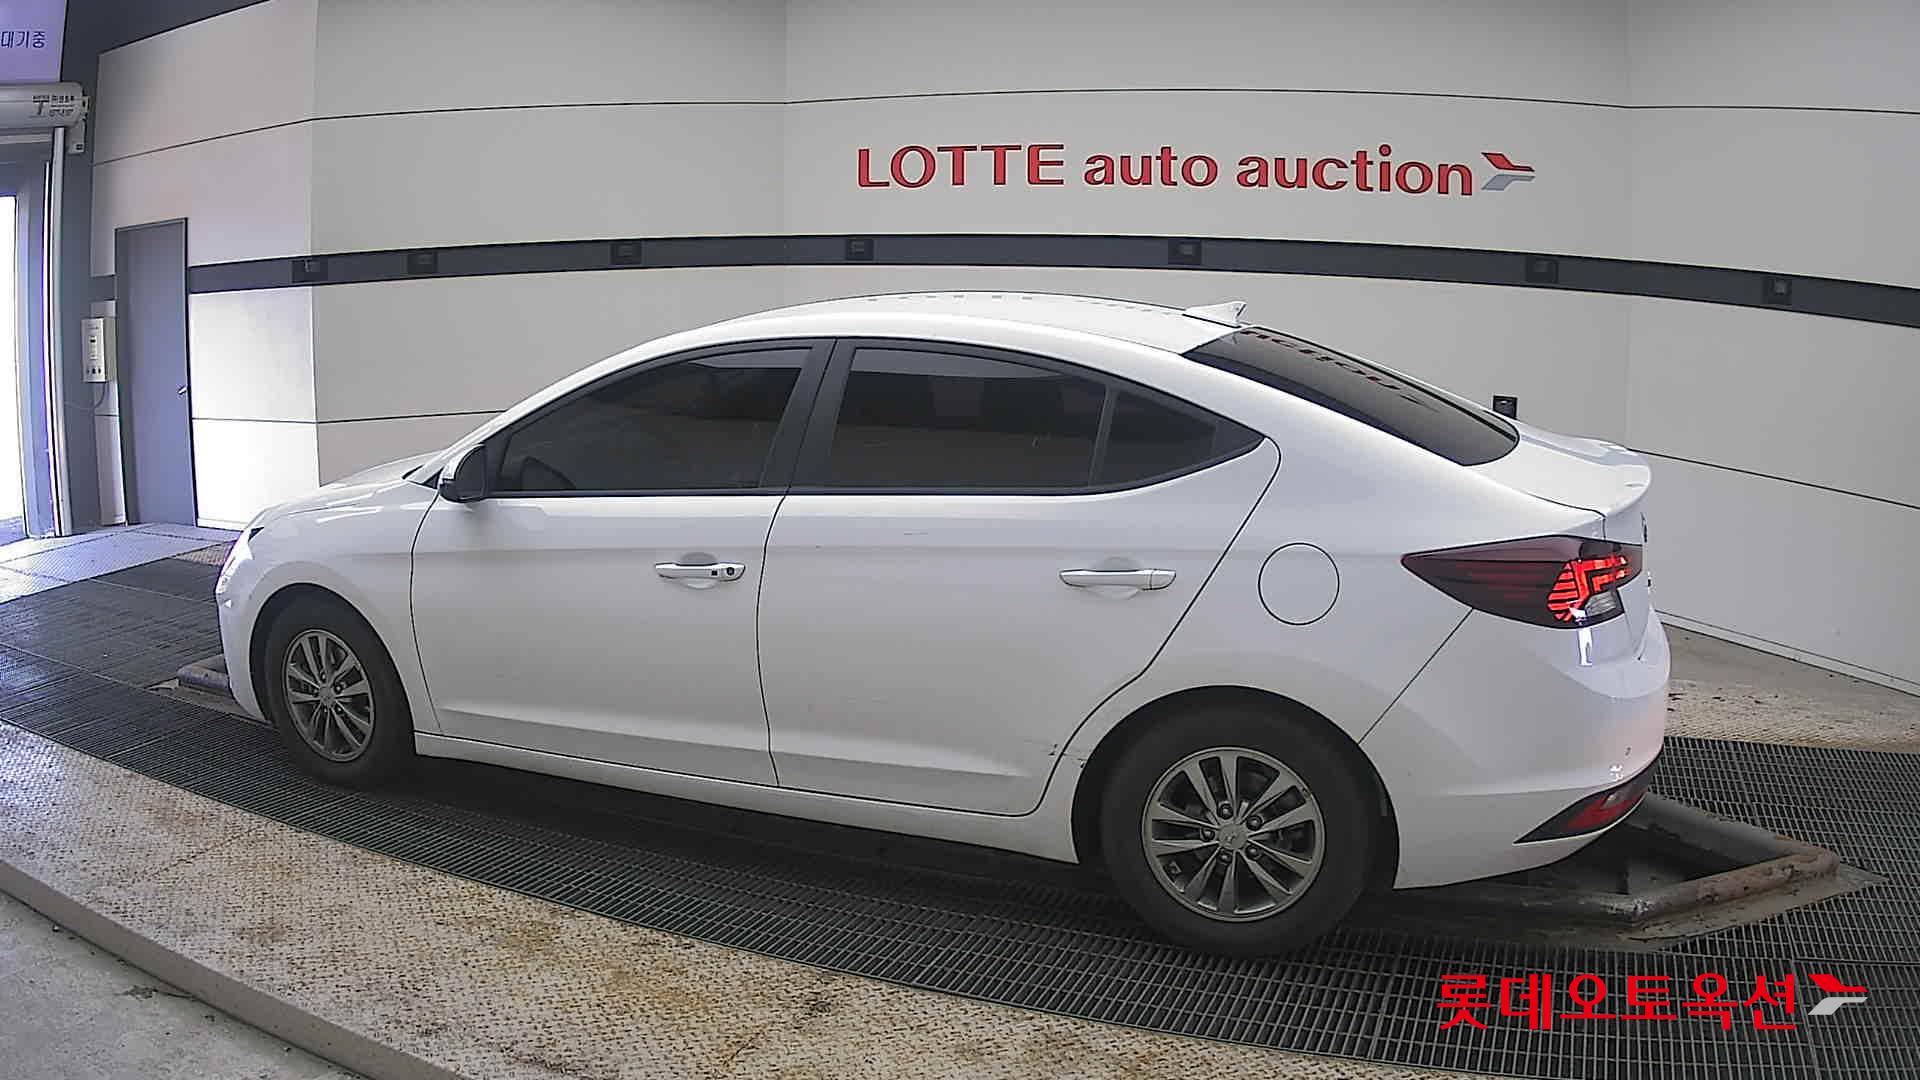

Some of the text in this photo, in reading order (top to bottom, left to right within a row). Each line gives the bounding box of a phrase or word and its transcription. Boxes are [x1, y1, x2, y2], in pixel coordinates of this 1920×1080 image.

[858, 144, 1473, 195] LOTTE auto auction
